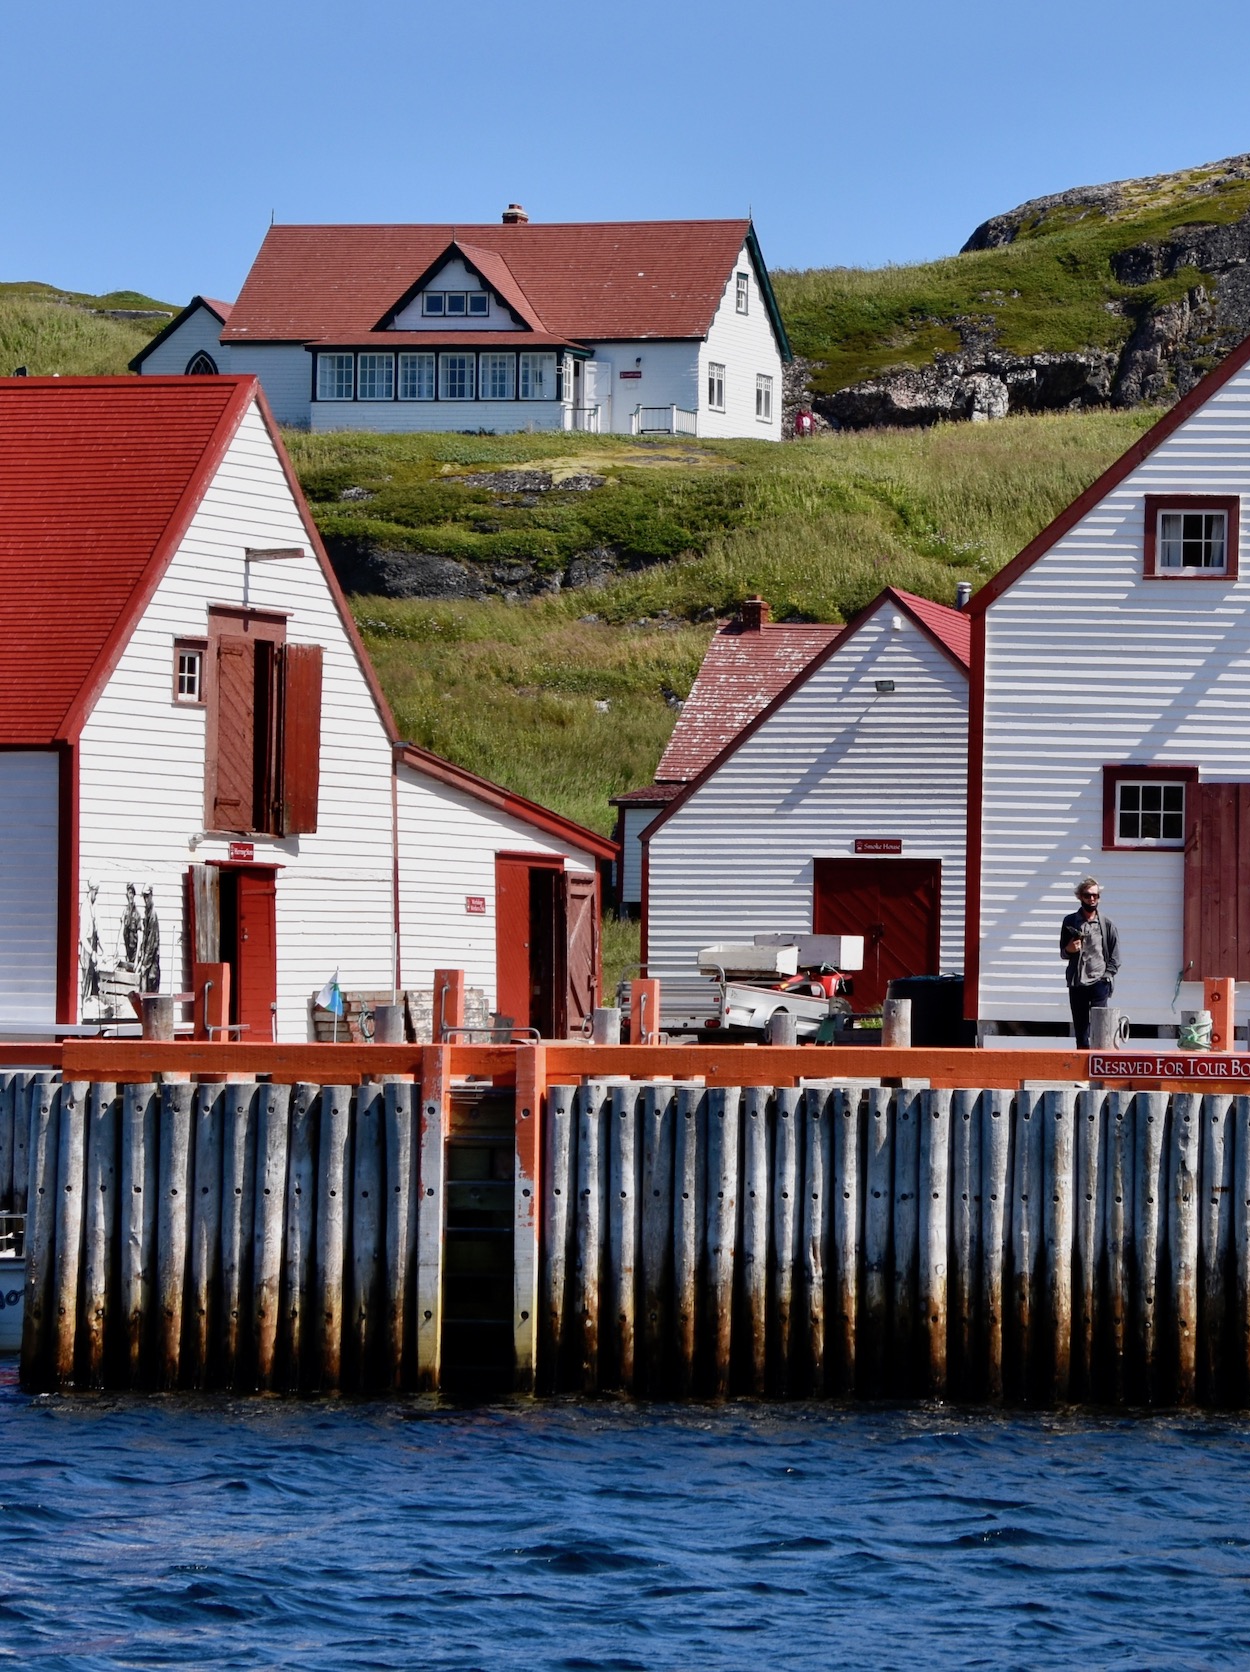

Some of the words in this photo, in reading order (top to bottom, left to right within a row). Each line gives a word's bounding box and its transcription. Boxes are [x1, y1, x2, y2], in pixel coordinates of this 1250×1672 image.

[1093, 1057, 1153, 1075] RESRVED
[1156, 1058, 1184, 1075] FOR
[1187, 1058, 1228, 1076] TOUR
